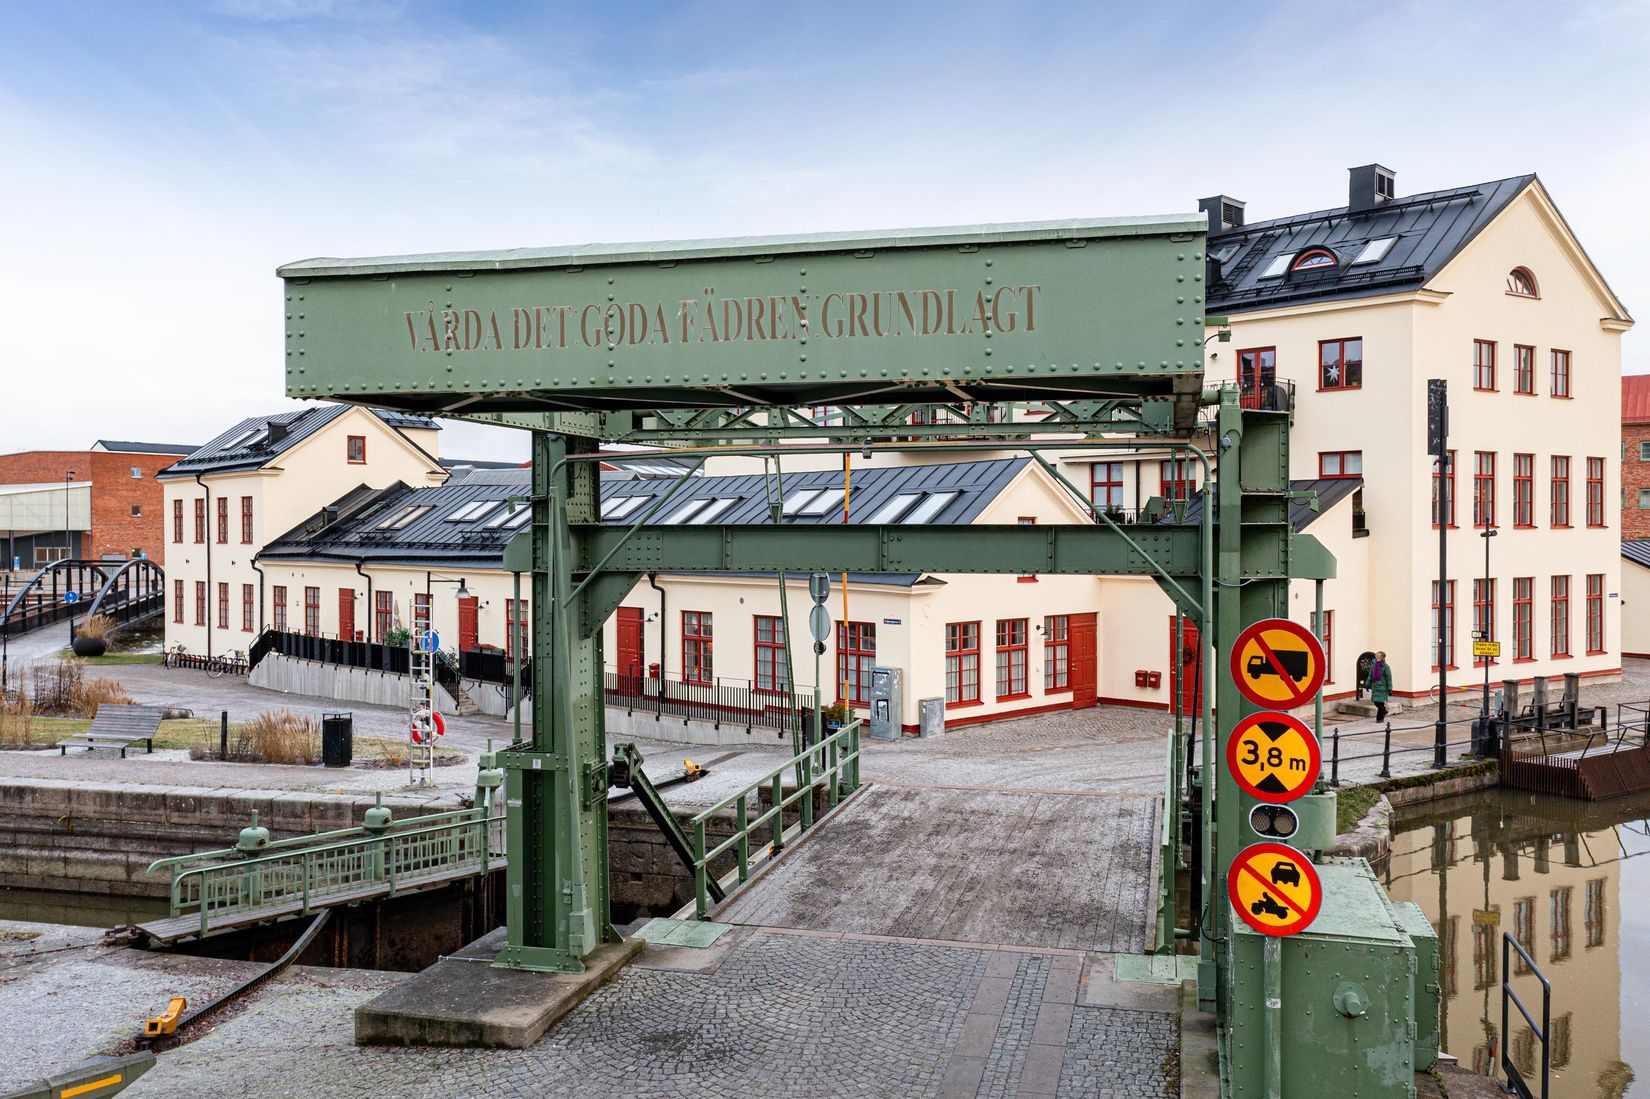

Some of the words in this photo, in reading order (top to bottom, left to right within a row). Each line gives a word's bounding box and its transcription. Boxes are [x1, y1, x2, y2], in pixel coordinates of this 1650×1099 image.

[403, 299, 504, 352] VÅRDA
[580, 301, 672, 349] GODA
[821, 285, 1041, 338] GRUNDLAGT
[1241, 739, 1283, 771] 3,8
[1289, 757, 1306, 772] m
